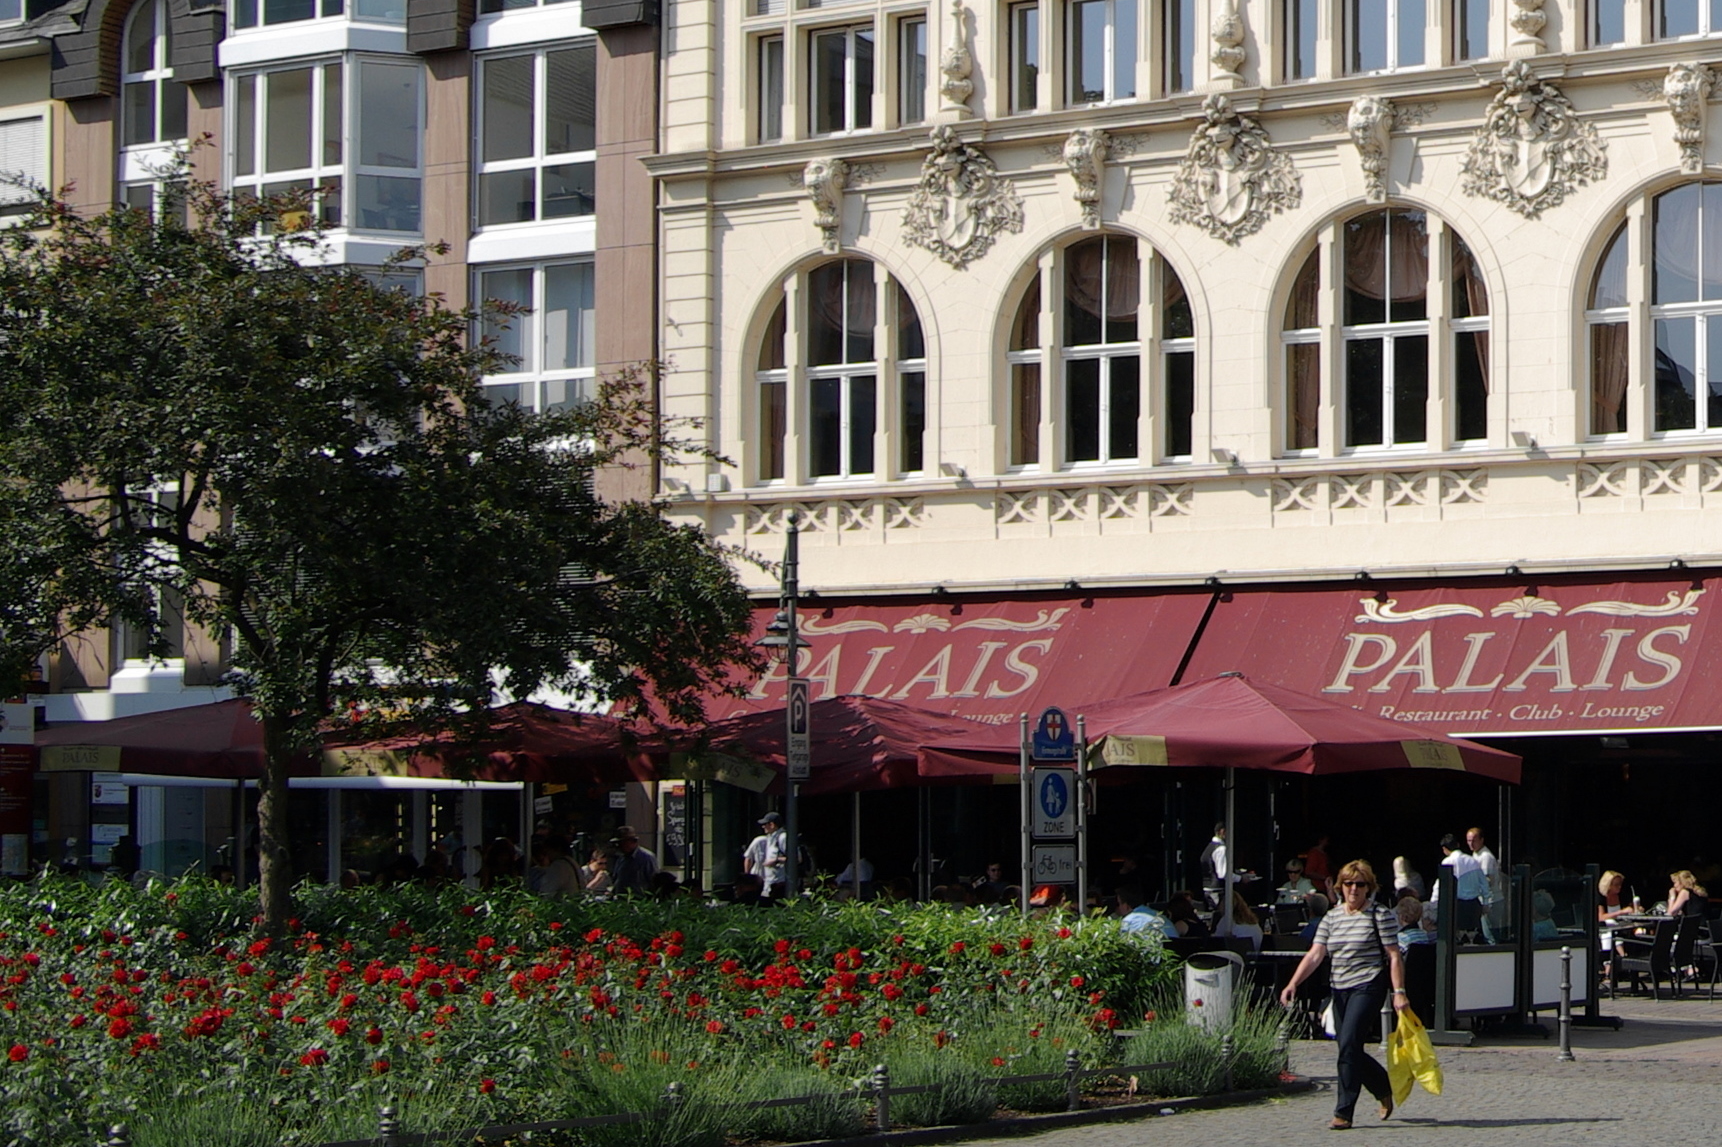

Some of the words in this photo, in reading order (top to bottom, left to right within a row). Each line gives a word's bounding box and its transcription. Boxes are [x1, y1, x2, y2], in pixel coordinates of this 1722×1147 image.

[1321, 623, 1691, 694] PALAIS
[746, 637, 1054, 701] PALAIS
[794, 699, 803, 732] P
[950, 710, 1014, 726] Lounge
[1380, 704, 1492, 722] Restaurant
[1508, 703, 1563, 721] Club
[1579, 702, 1665, 720] Lounge
[63, 752, 99, 763] PALAIS
[1043, 821, 1065, 833] ZONE
[1058, 858, 1073, 871] frei
